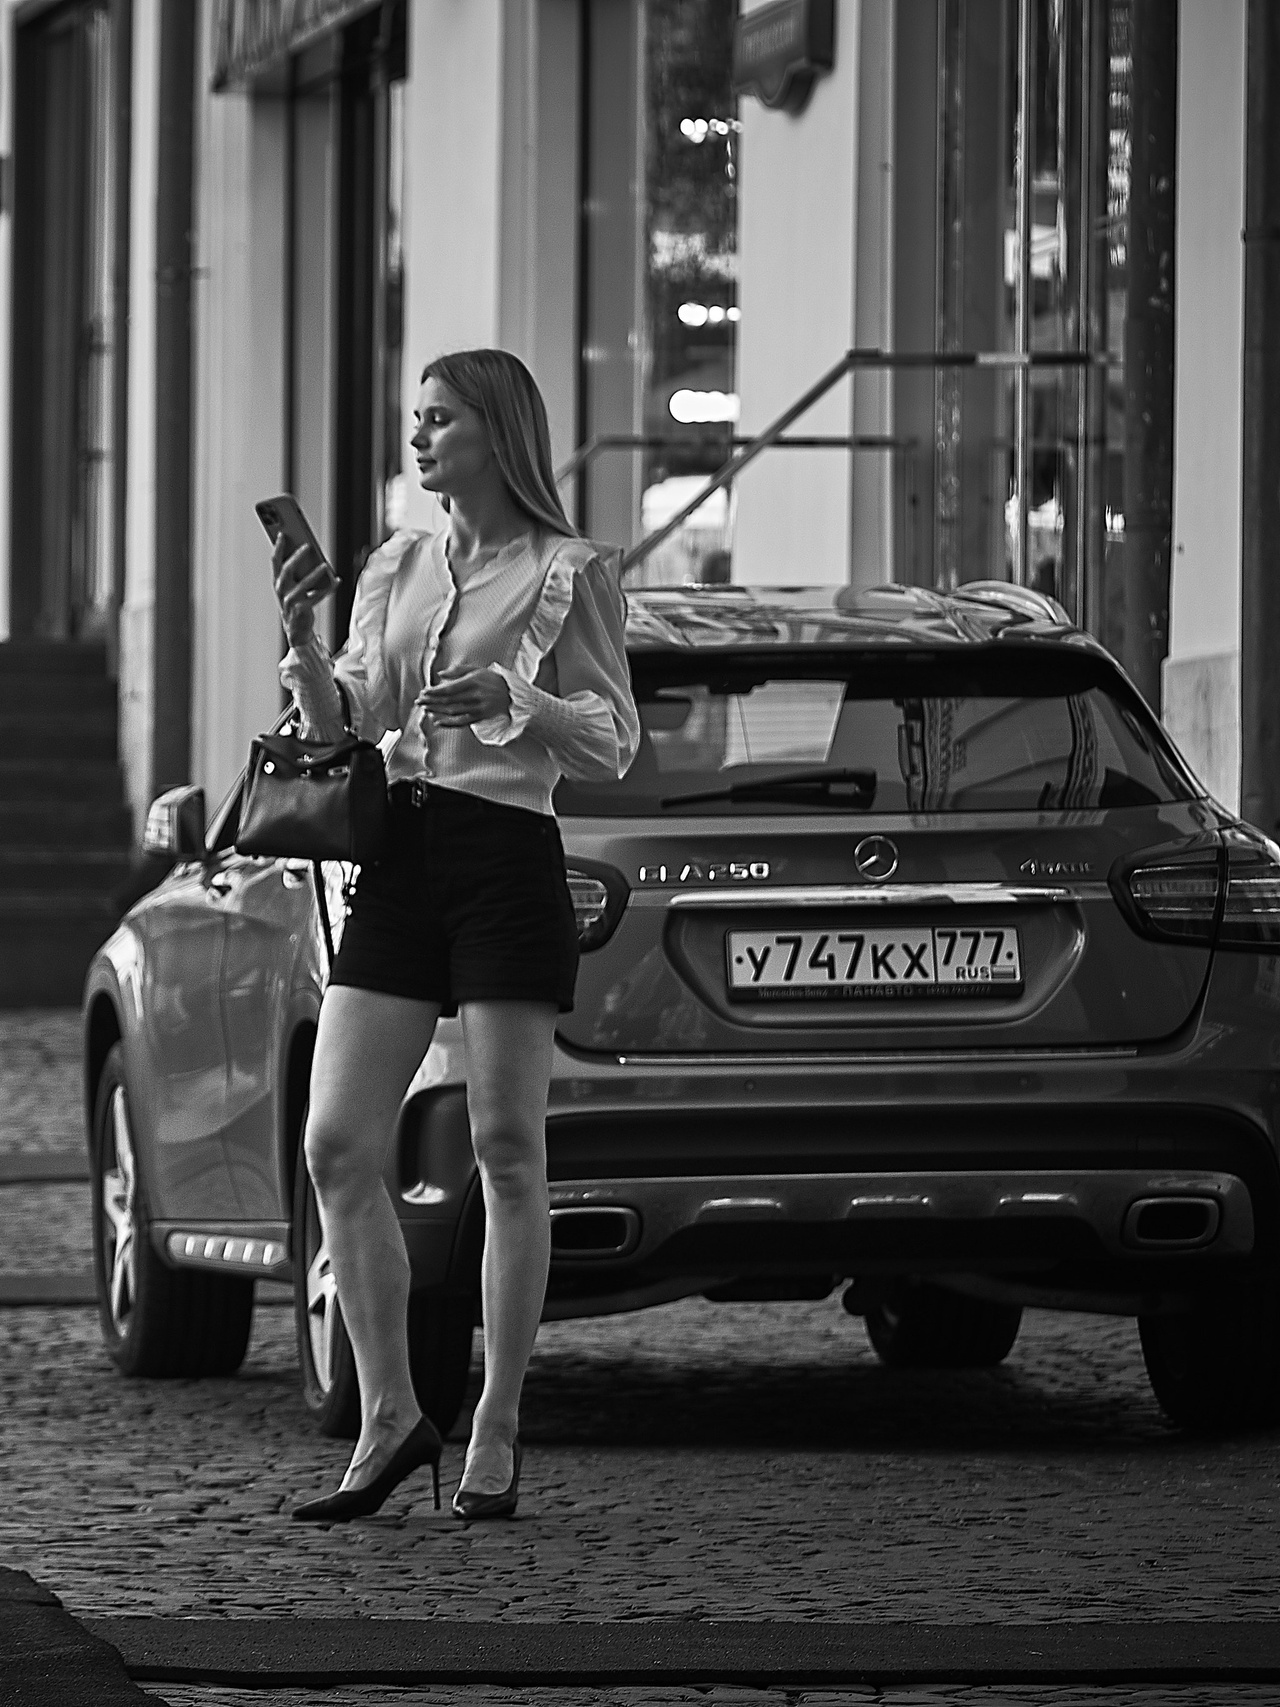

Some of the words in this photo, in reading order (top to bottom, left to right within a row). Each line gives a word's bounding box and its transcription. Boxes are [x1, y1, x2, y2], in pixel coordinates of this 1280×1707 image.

[708, 862, 770, 880] 250
[936, 931, 1005, 966] 777
[955, 966, 990, 980] RUS
